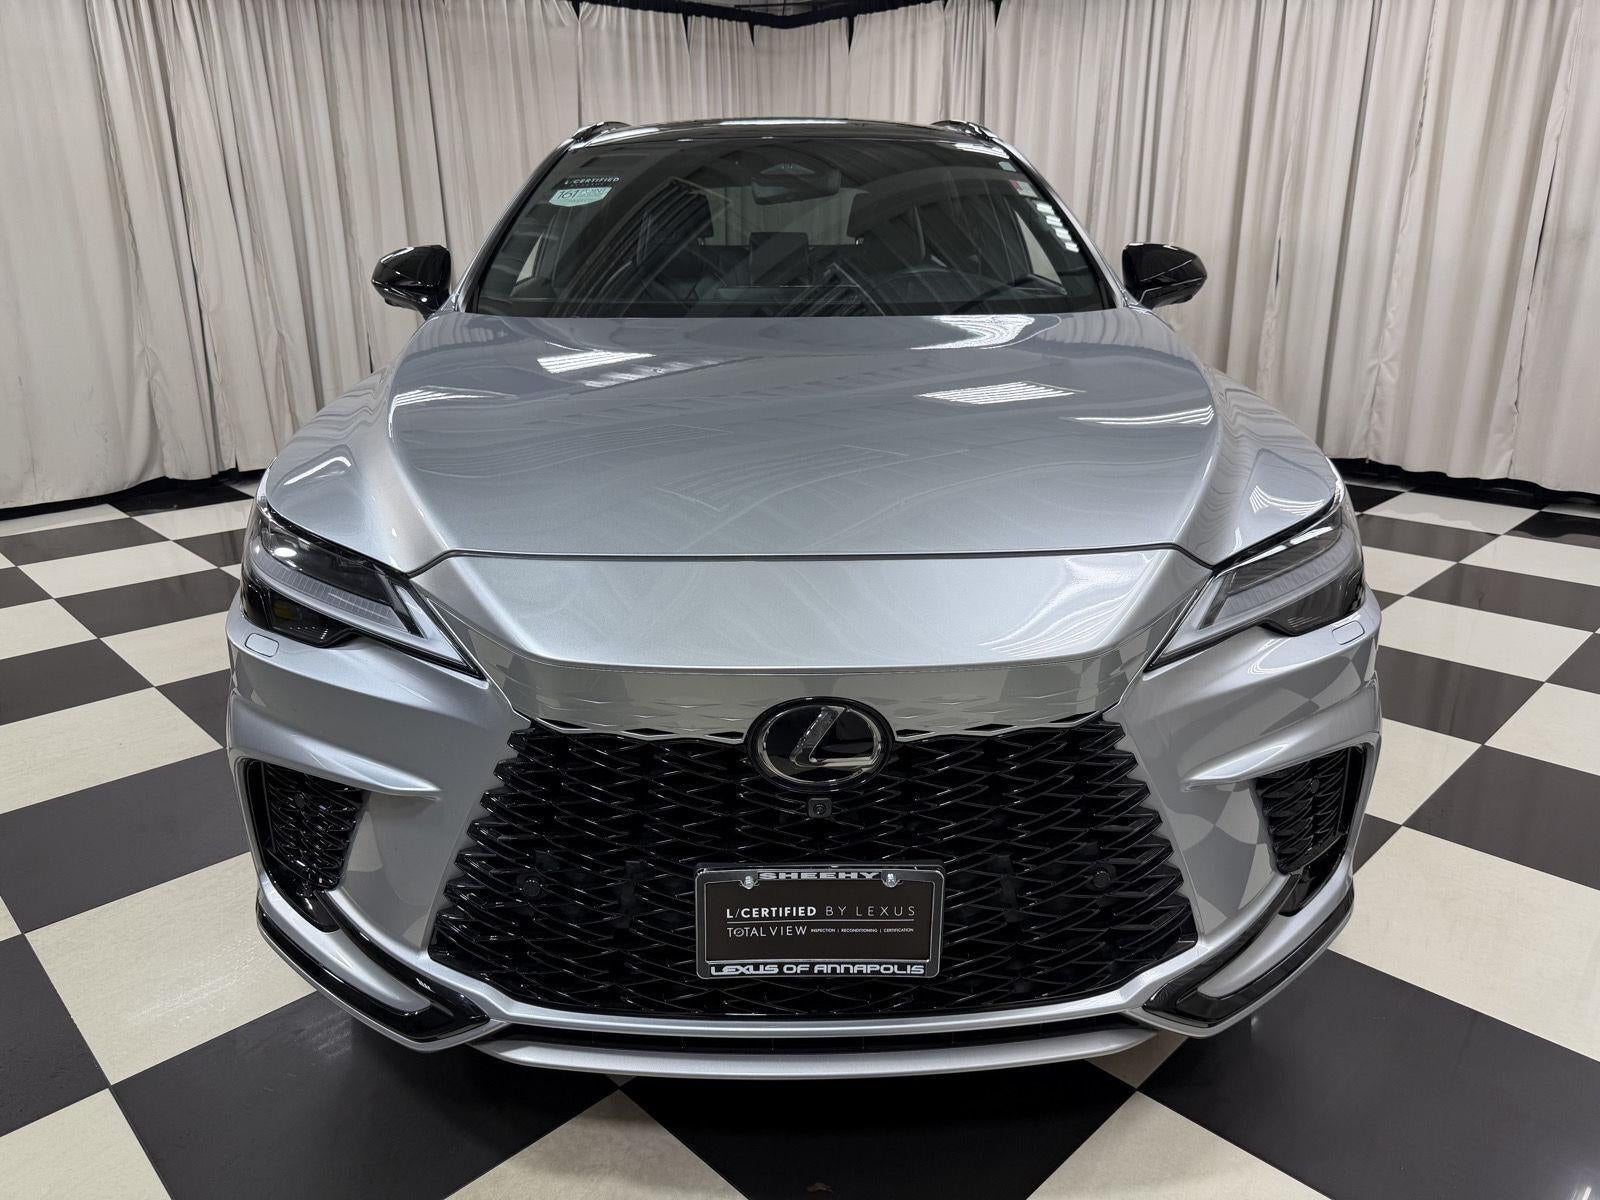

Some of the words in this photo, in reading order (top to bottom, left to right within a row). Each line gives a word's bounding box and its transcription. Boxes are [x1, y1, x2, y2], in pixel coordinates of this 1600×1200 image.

[558, 189, 579, 199] 161
[758, 872, 879, 880] SHEEHY
[825, 906, 847, 917] BY
[856, 905, 915, 917] LEXUS
[710, 964, 779, 975] LEXUS
[782, 964, 810, 975] OF
[813, 964, 925, 975] ANNAPOLIS
